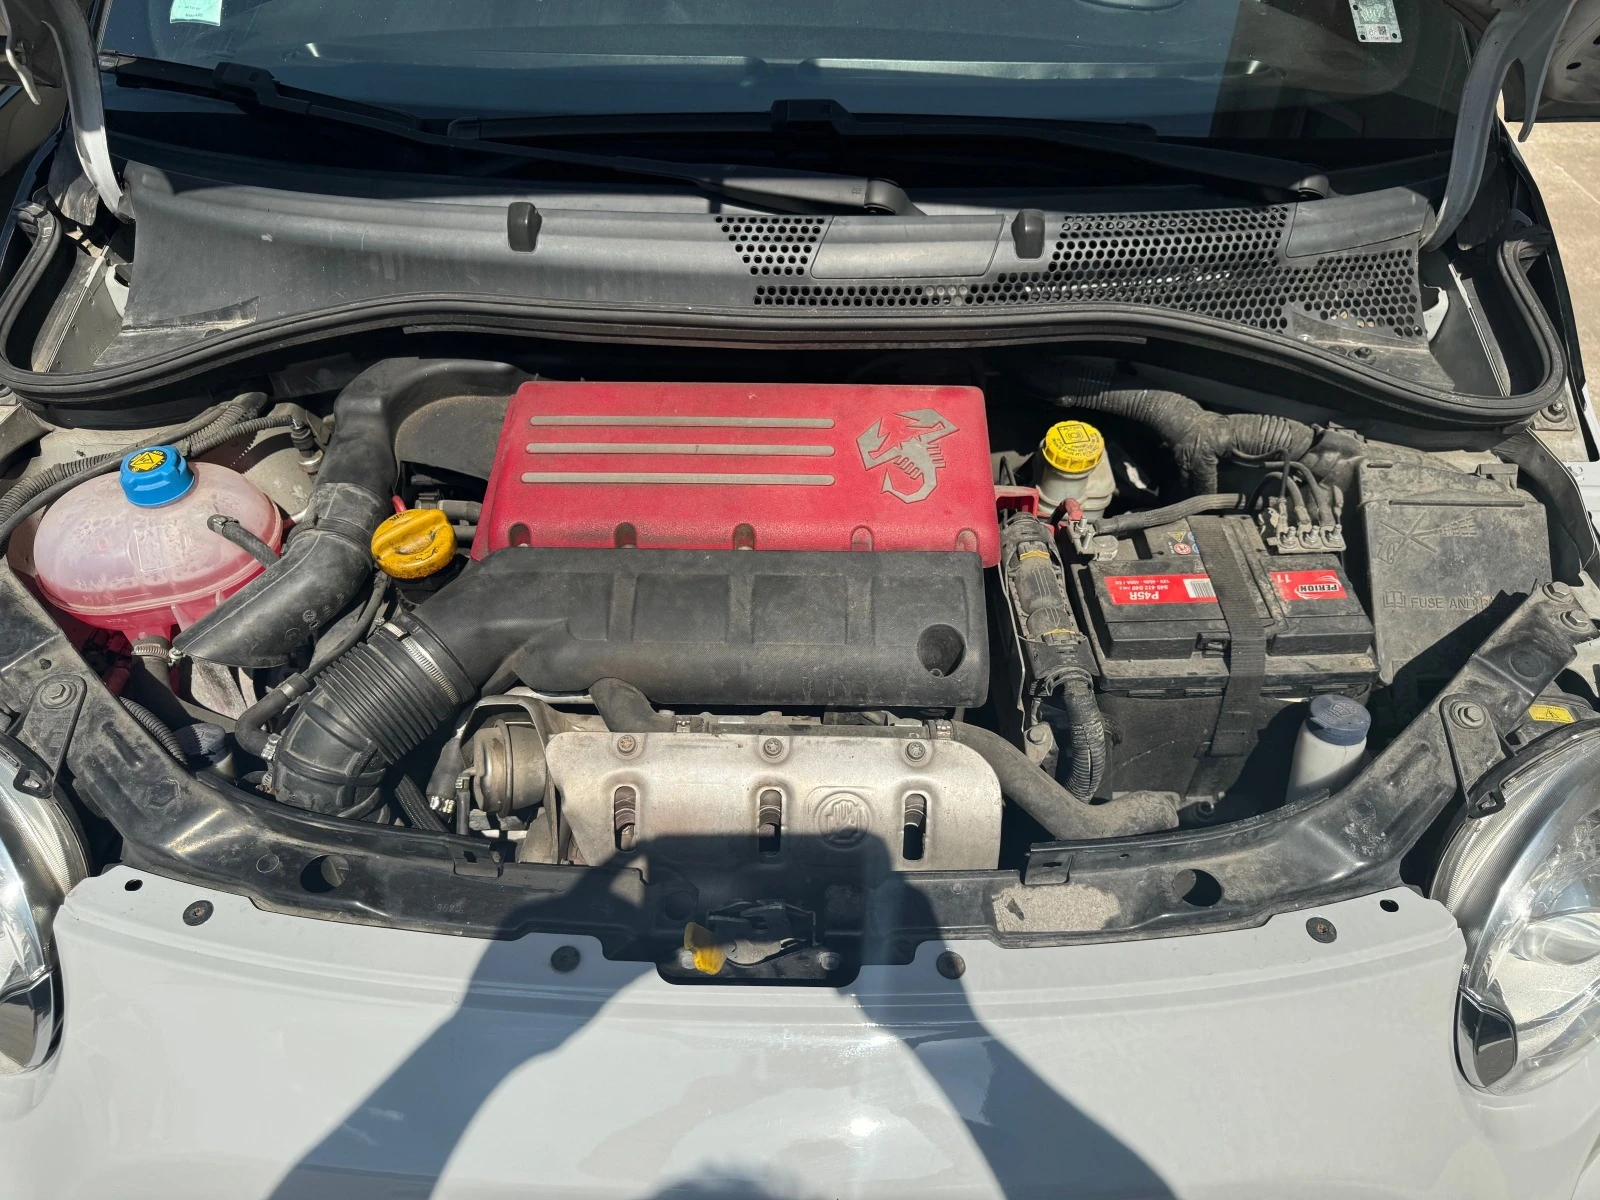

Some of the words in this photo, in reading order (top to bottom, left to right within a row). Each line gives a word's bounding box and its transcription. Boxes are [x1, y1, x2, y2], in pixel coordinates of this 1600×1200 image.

[1277, 574, 1291, 583] 11
[1300, 584, 1338, 592] PERION
[1129, 591, 1159, 601] P45R
[1411, 597, 1444, 608] FUSE
[1449, 597, 1476, 610] AND
